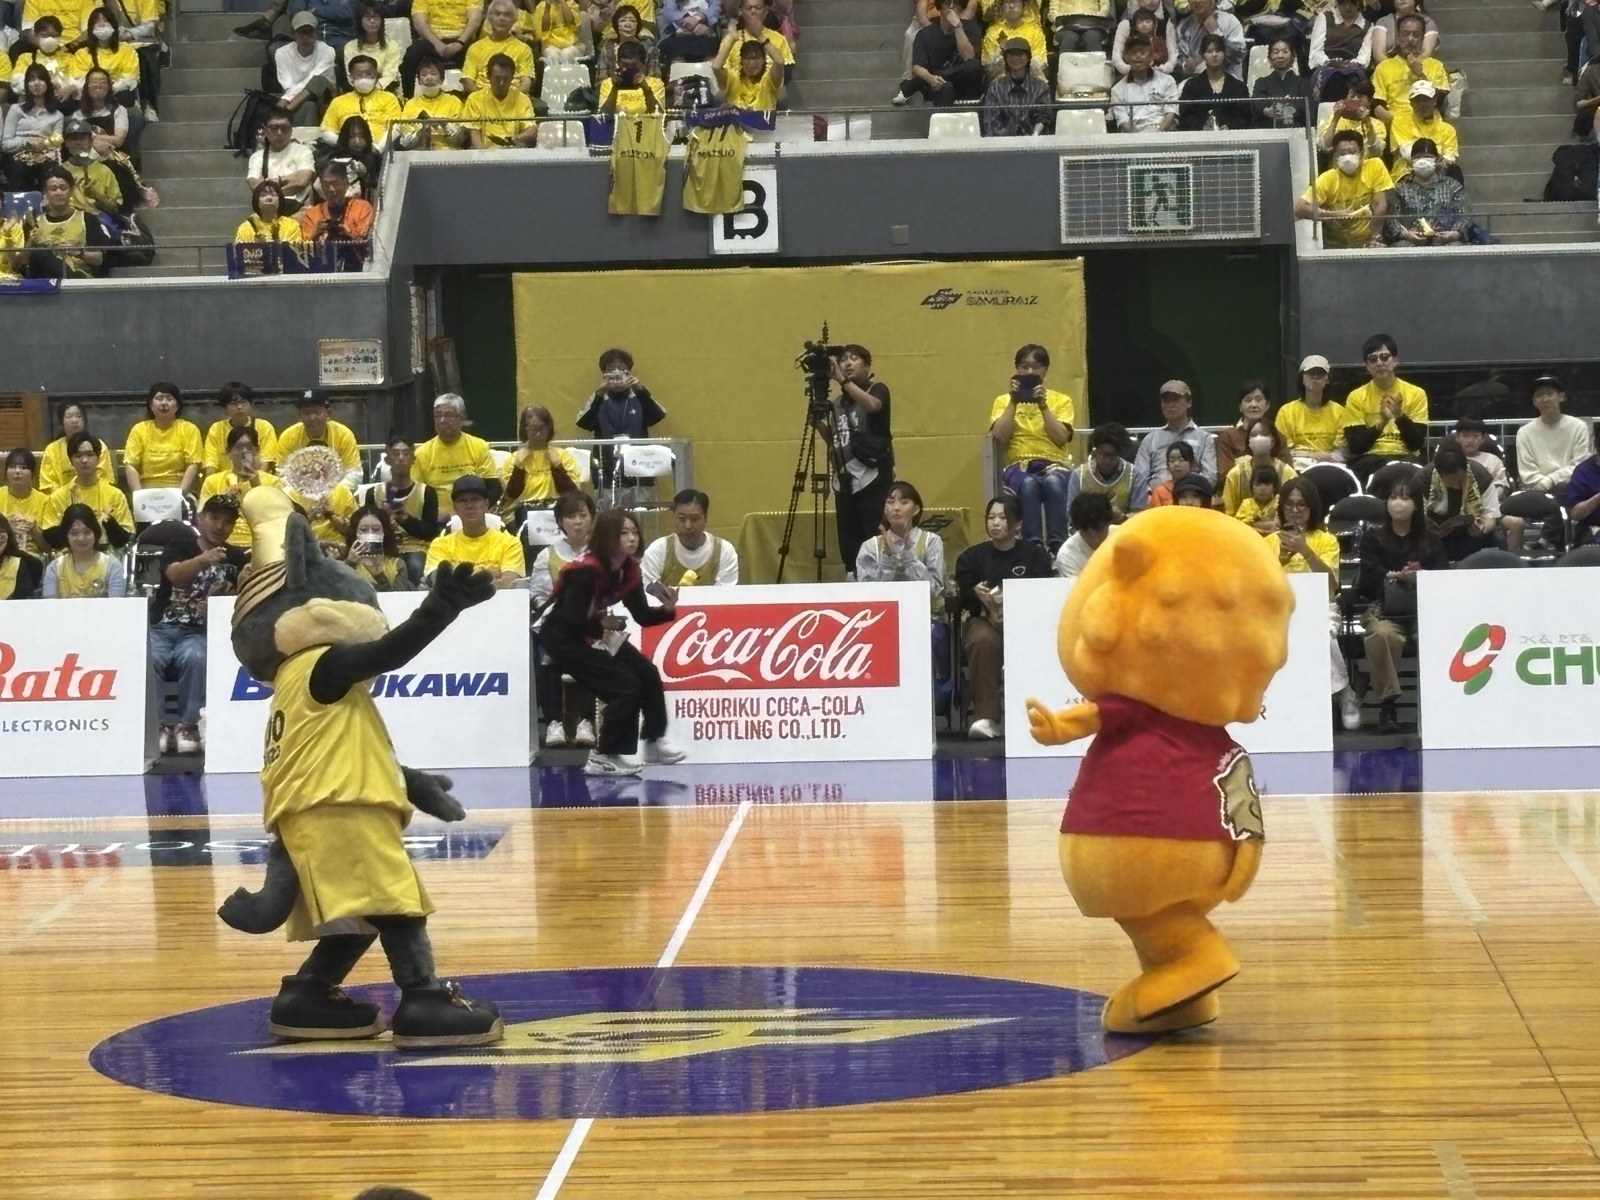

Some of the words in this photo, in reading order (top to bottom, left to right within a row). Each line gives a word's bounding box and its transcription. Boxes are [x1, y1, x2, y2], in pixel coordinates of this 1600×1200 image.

[633, 120, 643, 144] 1
[723, 179, 769, 240] B
[652, 608, 888, 684] Coca-Cola
[1515, 645, 1600, 686] CH
[675, 696, 761, 719] HOKURIKU
[766, 695, 865, 718] COCA-COLA
[693, 718, 773, 741] BOTTLING
